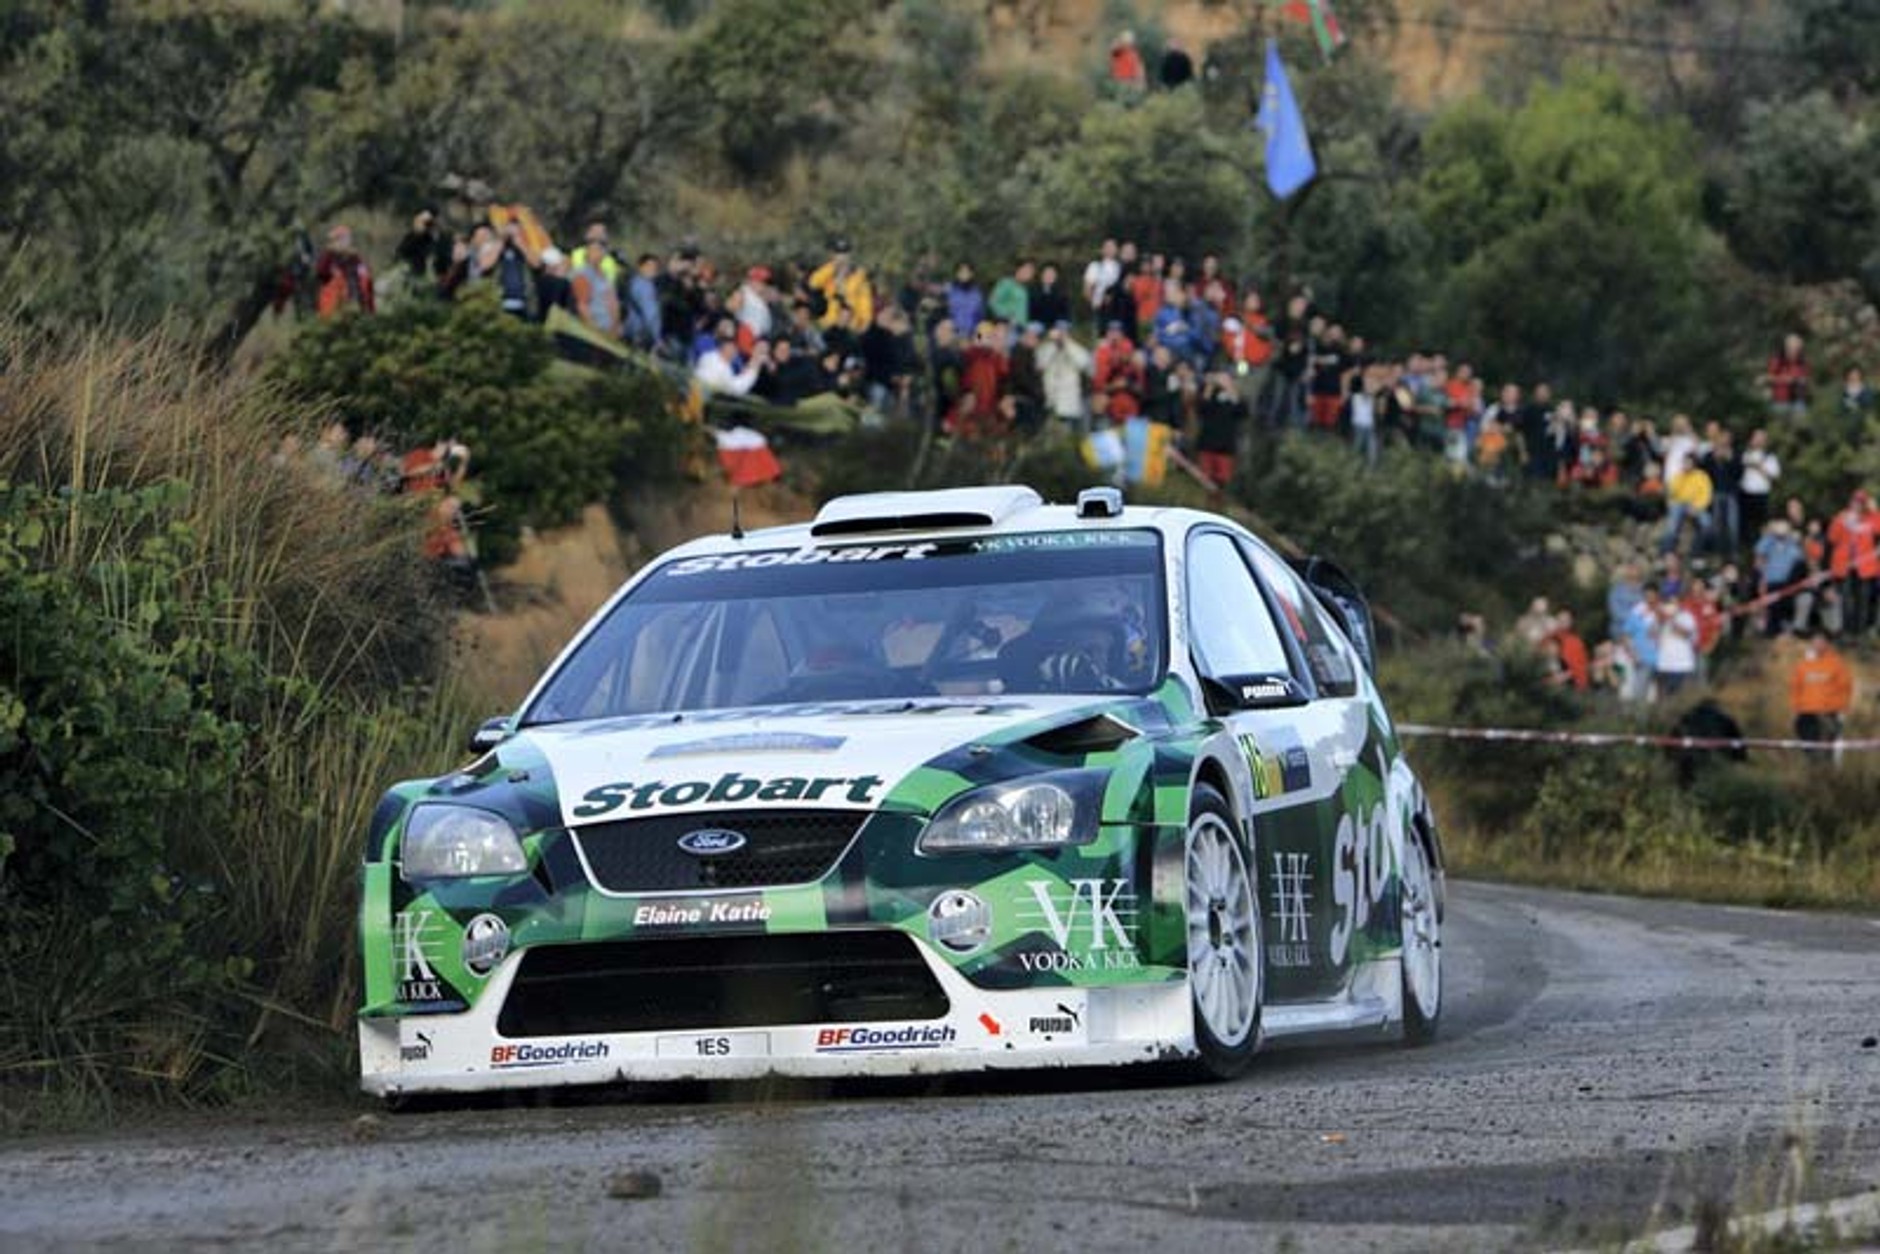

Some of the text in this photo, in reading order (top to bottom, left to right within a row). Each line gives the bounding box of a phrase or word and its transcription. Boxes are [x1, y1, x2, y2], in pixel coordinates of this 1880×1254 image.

[667, 541, 938, 576] Stobart
[573, 772, 884, 817] Stobart
[633, 901, 772, 926] Elaine Katie
[1025, 878, 1135, 950] VK
[1019, 951, 1097, 971] VODKA
[1029, 1016, 1073, 1033] PUMA
[818, 1025, 956, 1046] BFGoodrich
[491, 1042, 609, 1063] BFGoodrich
[696, 1038, 731, 1056] 1ES
